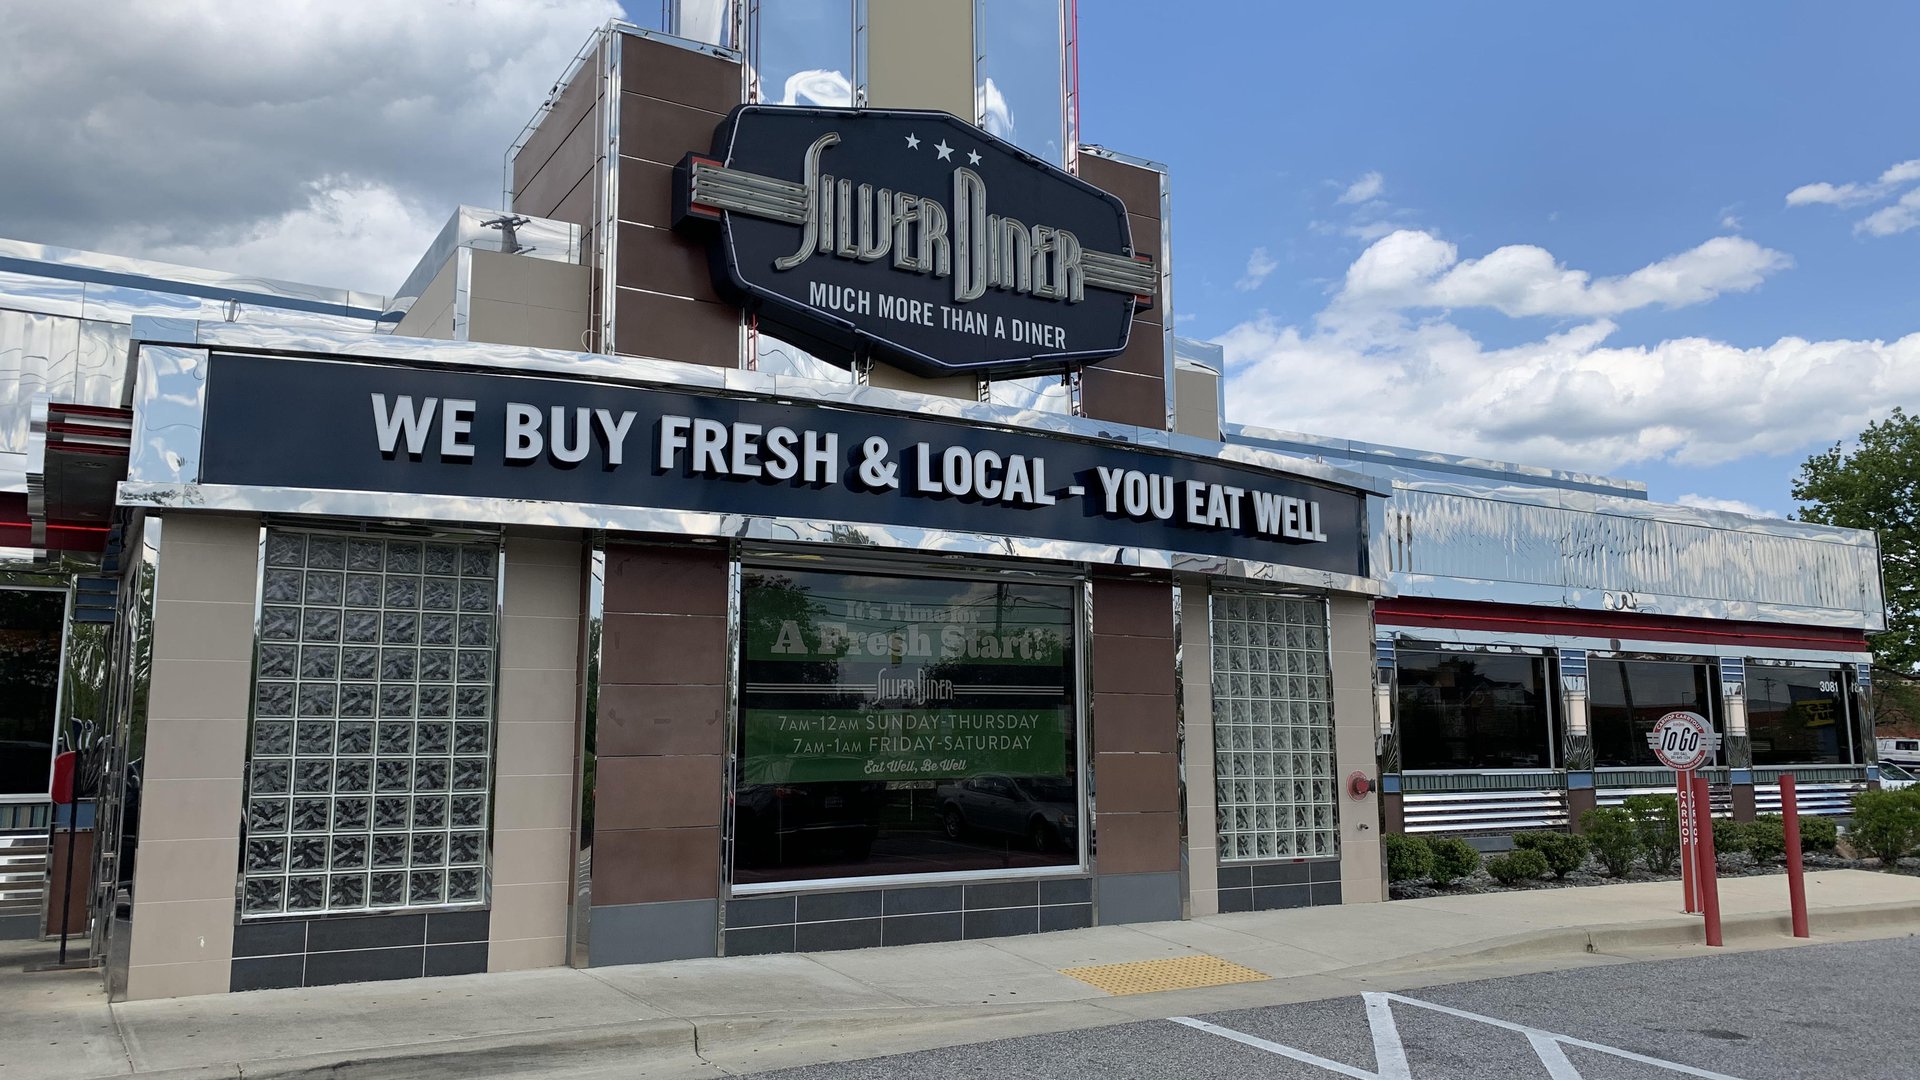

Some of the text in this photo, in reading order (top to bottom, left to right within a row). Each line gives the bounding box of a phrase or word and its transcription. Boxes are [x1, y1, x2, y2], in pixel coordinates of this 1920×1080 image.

[953, 167, 1084, 302] DINER
[809, 281, 1066, 350] MUCH MORE THAN A DINER
[371, 392, 1327, 544] WE BUY FRESH & LOCAL - YOU EAT WELL
[886, 600, 943, 622] Time
[950, 607, 981, 624] for
[770, 620, 808, 654] A
[817, 621, 933, 657] Fresh
[1819, 681, 1838, 692] 3081
[778, 714, 1040, 732] 7AM-12AM SUNDAY-THURSDAY
[1656, 714, 1675, 730] CARHOP
[793, 735, 1033, 754] 7AM-1AM FRIDAY-SATURDAY
[864, 757, 967, 775] Eat Well, Be Well
[1680, 790, 1690, 845] CARHOP
